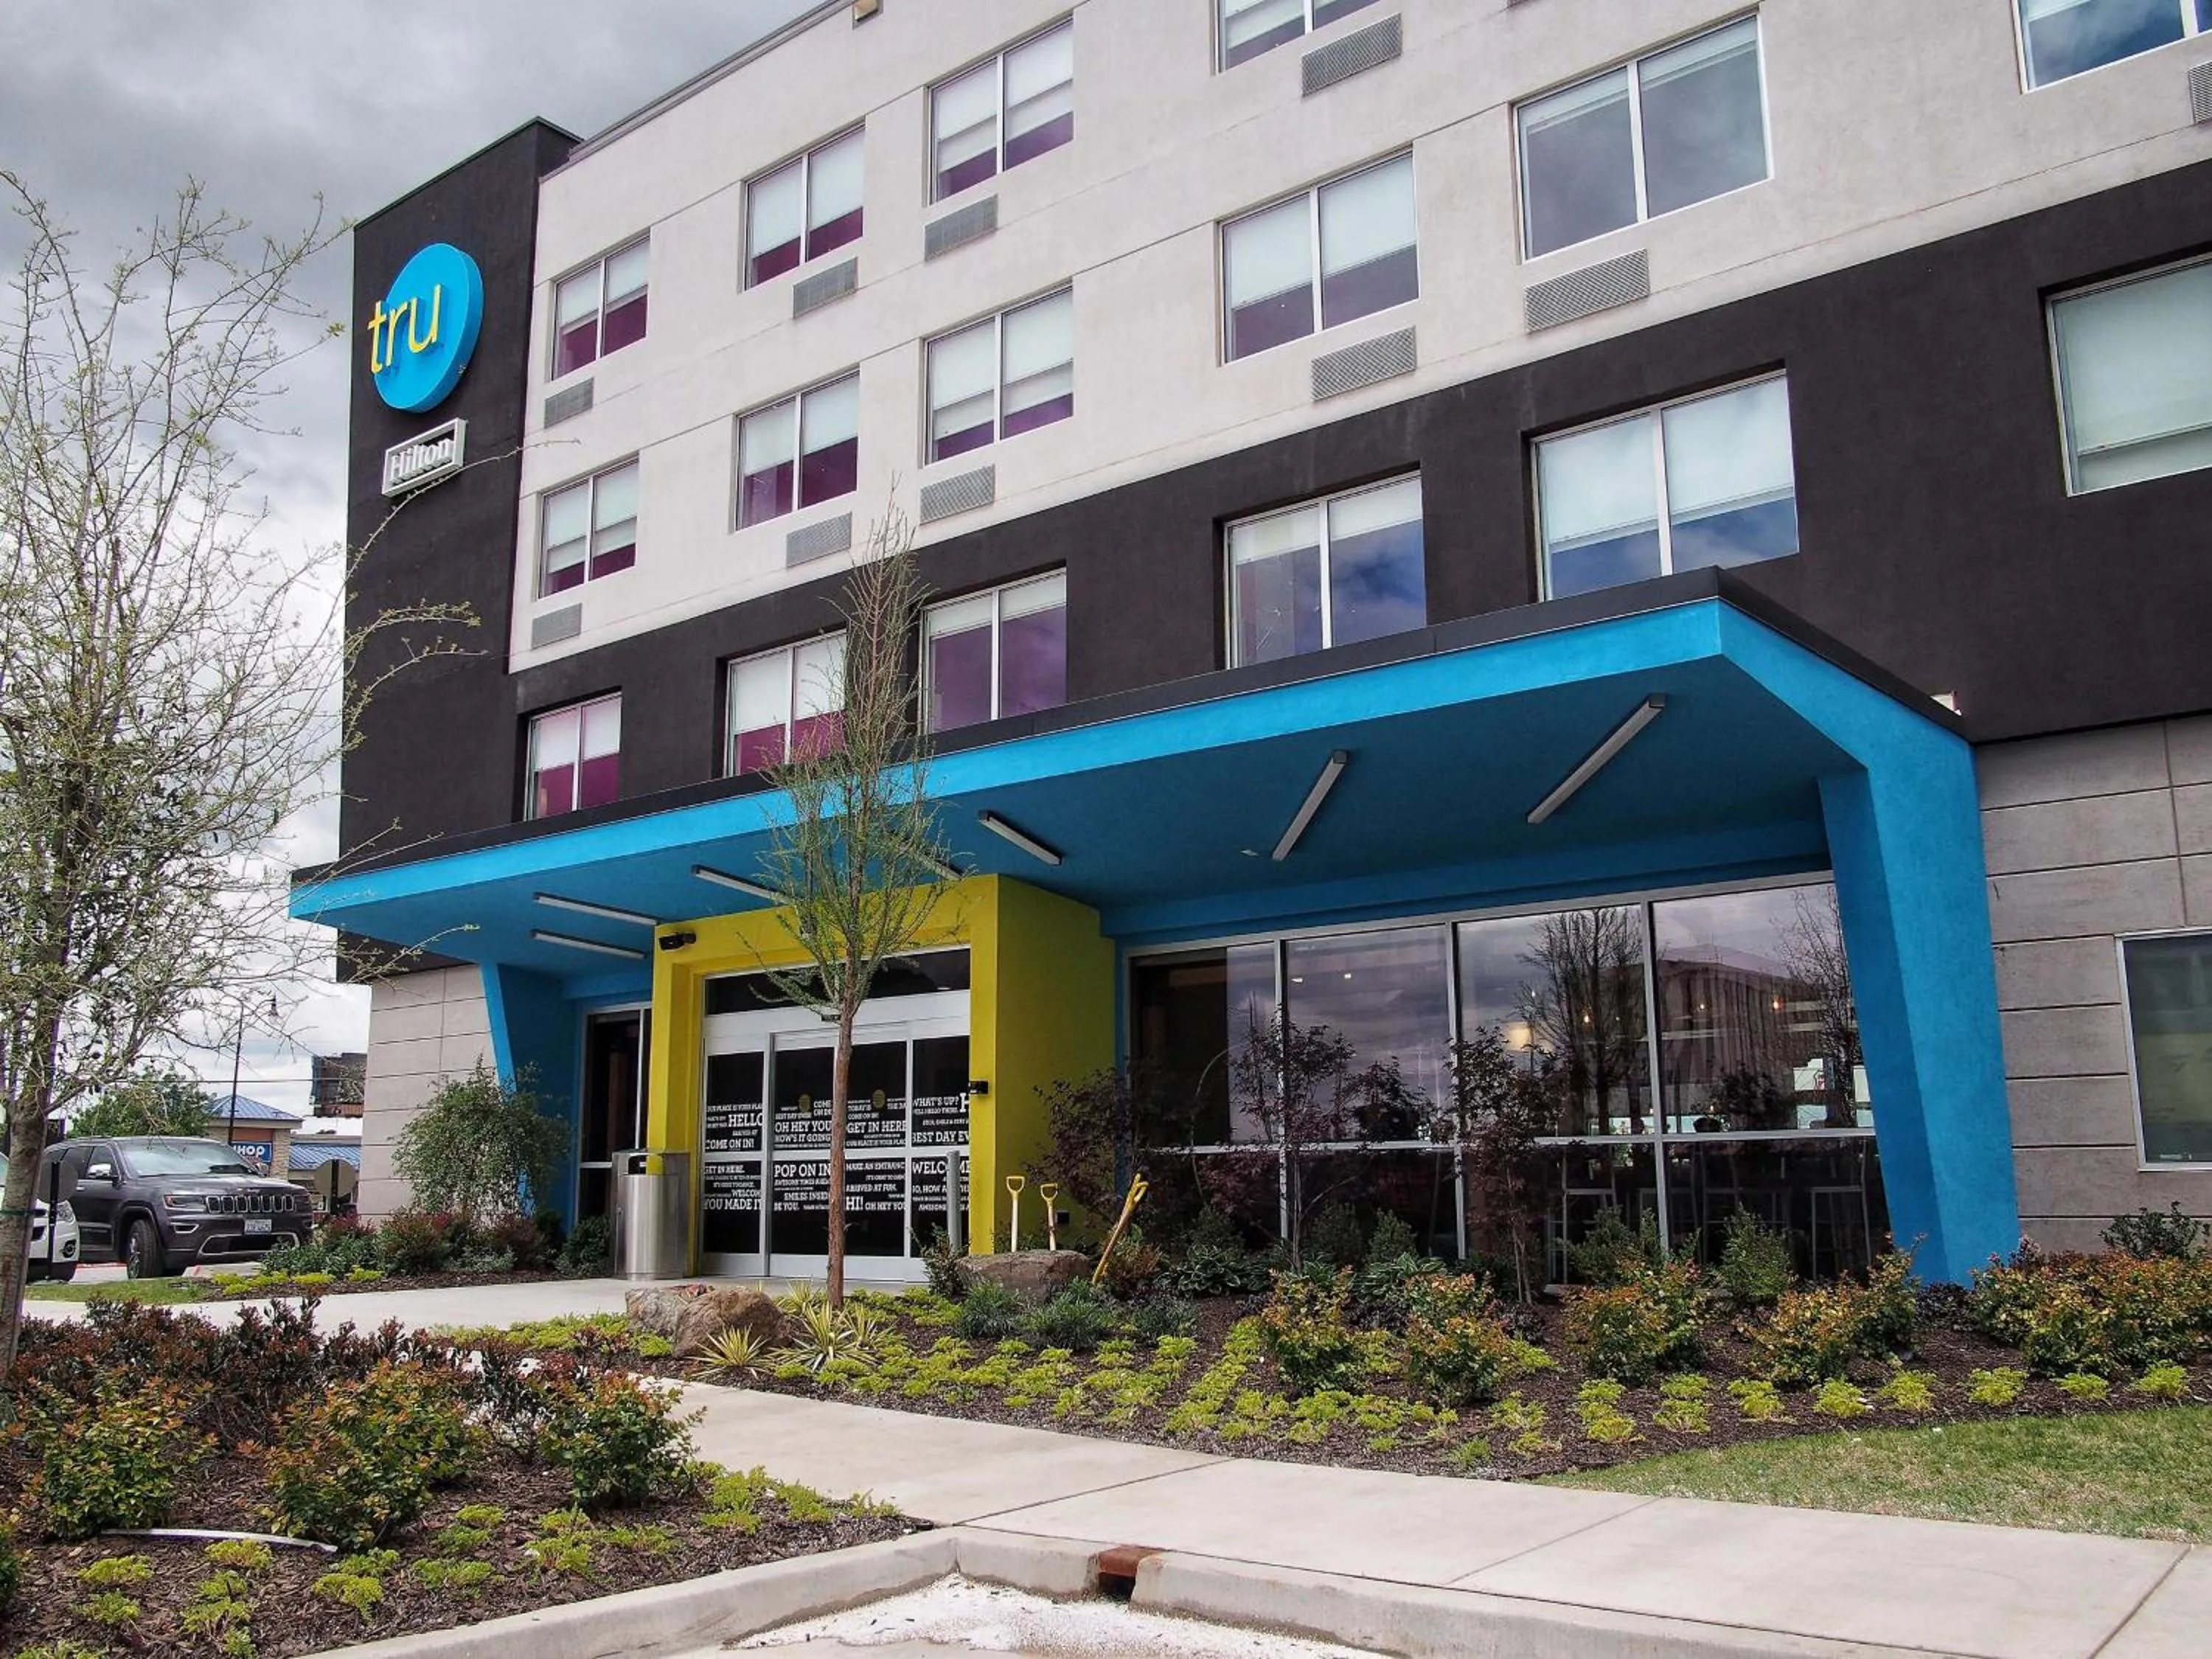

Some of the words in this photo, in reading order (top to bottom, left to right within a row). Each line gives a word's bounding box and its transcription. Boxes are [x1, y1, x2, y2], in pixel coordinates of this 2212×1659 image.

[367, 283, 442, 374] tru
[390, 438, 454, 483] Hilton
[775, 1121, 790, 1133] OH
[790, 1121, 810, 1133] HEY
[812, 1120, 832, 1132] YOU
[847, 1121, 866, 1133] GET
[868, 1121, 880, 1133] IN
[799, 1133, 807, 1142] IT
[936, 1131, 957, 1142] DAY
[728, 1138, 741, 1149] ON
[774, 1164, 797, 1178] POP
[799, 1164, 816, 1178] ON
[912, 1160, 970, 1174] WELCME
[922, 1185, 941, 1194] HOW
[704, 1198, 723, 1210] YOU
[724, 1198, 753, 1210] MADE
[846, 1196, 863, 1211] HI!
